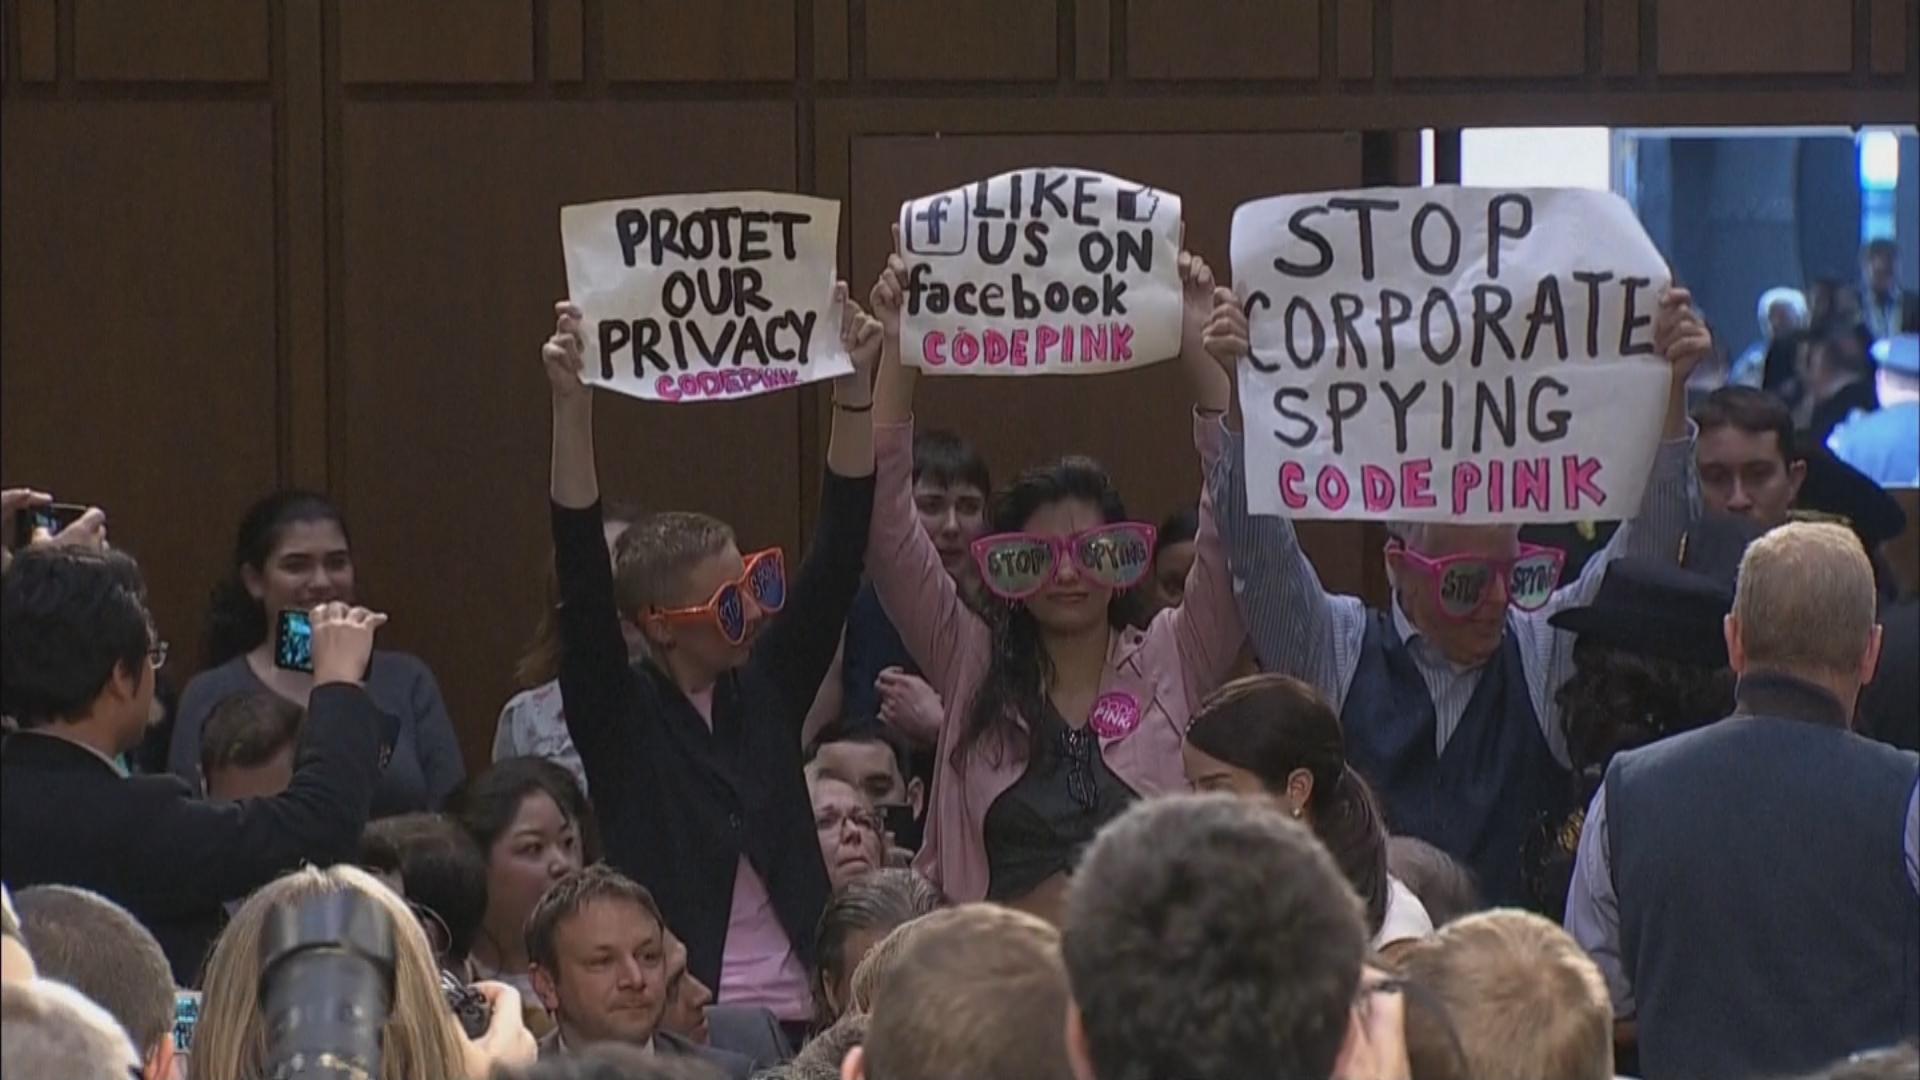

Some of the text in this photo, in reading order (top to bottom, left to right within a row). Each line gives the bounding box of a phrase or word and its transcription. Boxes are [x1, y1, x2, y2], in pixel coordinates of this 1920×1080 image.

[973, 173, 1102, 226] LIKE
[615, 207, 812, 267] PROTET
[977, 220, 1153, 274] US ON
[1273, 193, 1533, 281] STOP
[662, 267, 773, 318] OUR
[907, 263, 1128, 319] facebook
[598, 309, 817, 380] PRIVACY
[922, 322, 1135, 367] CODEPINK
[1243, 270, 1656, 374] CORPORATE
[1273, 375, 1572, 454] SPYING
